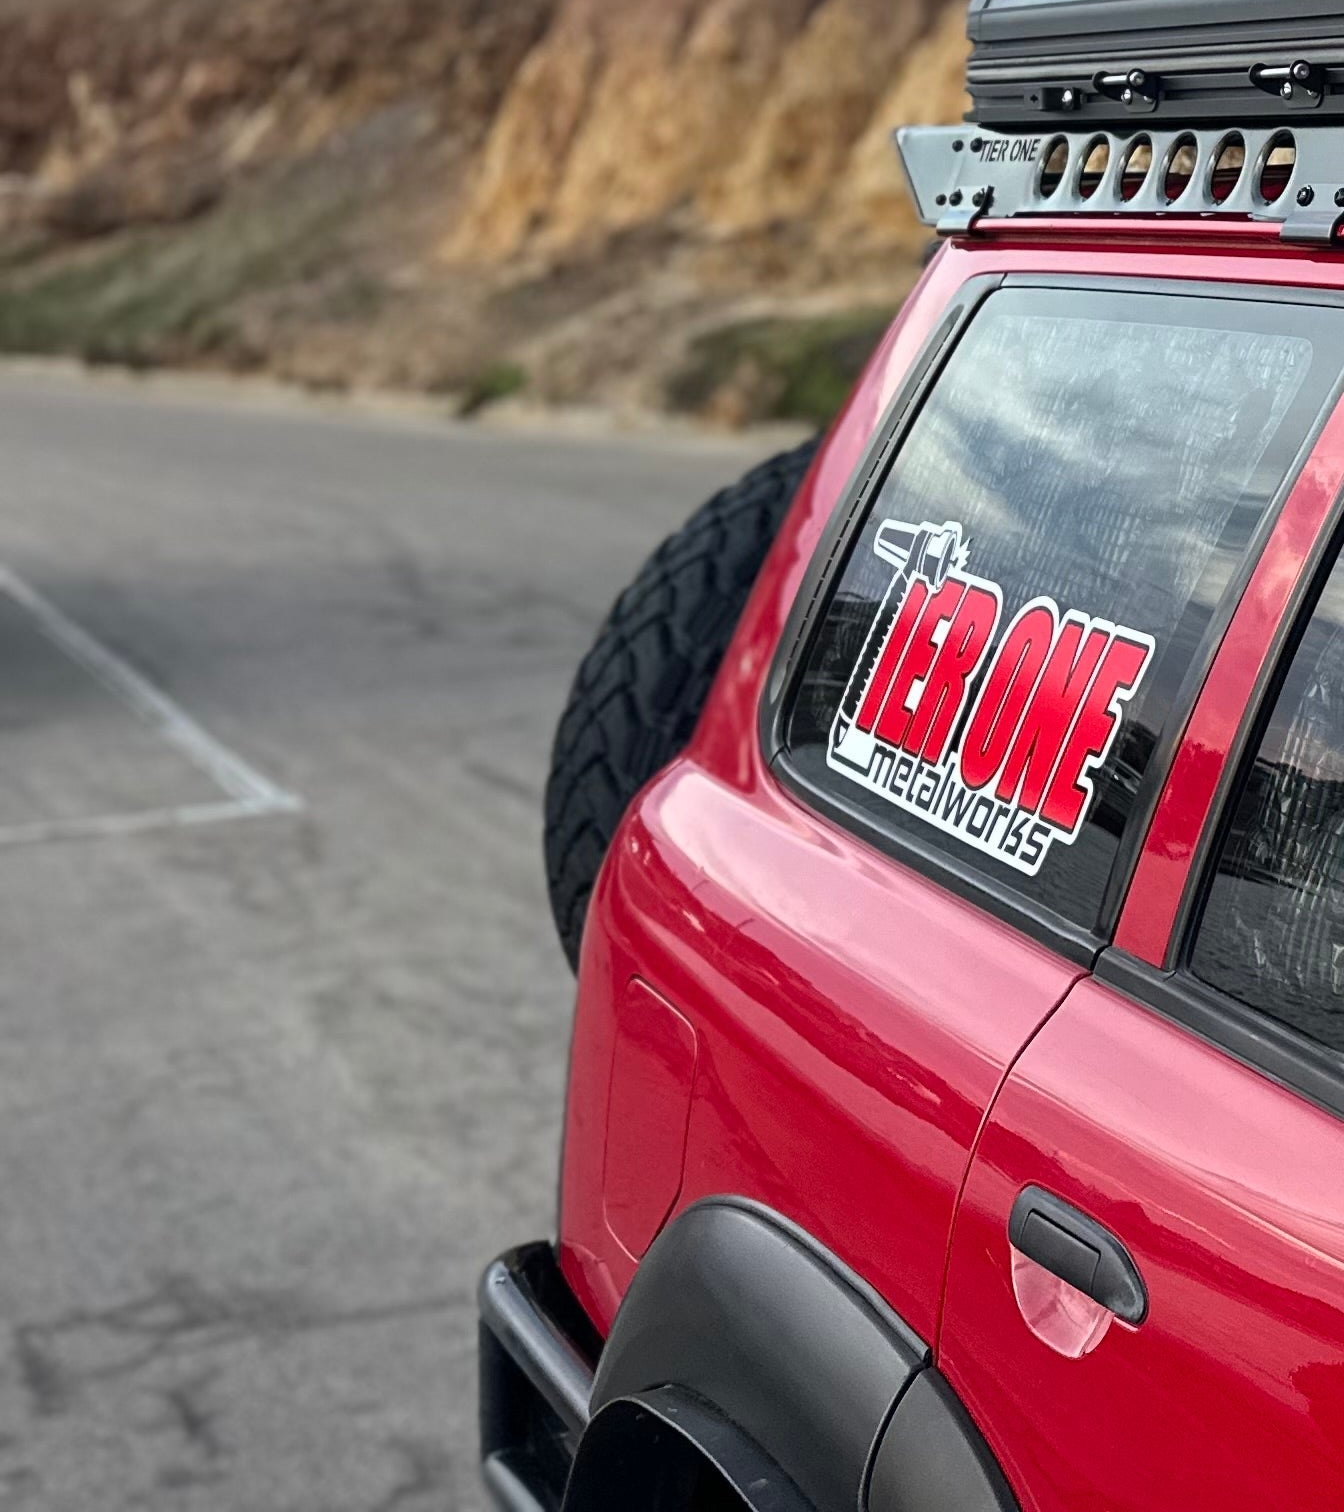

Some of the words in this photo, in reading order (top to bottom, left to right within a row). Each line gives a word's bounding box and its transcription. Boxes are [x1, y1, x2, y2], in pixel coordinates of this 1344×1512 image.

[980, 139, 1010, 162] TIER
[1010, 138, 1041, 162] ONE
[960, 605, 1152, 834] ONE
[870, 743, 1054, 866] metalworks
